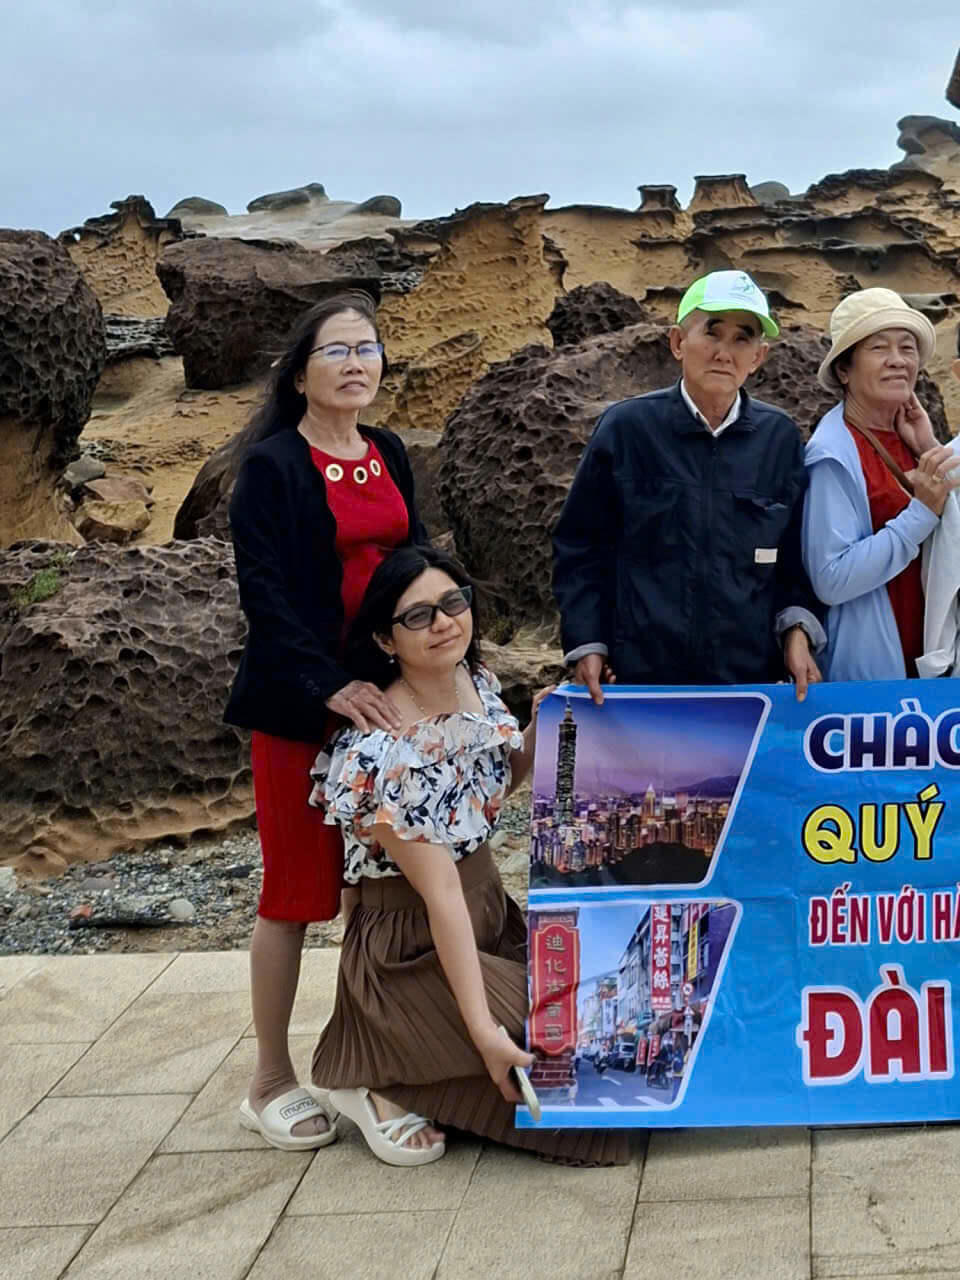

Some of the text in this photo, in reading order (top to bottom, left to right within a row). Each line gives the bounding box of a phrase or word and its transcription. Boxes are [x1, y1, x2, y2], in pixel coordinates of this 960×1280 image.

[802, 784, 945, 864] QUÝ
[810, 885, 869, 944] ĐẾN
[878, 887, 925, 942] VỚI
[803, 970, 948, 1079] ĐÀI
